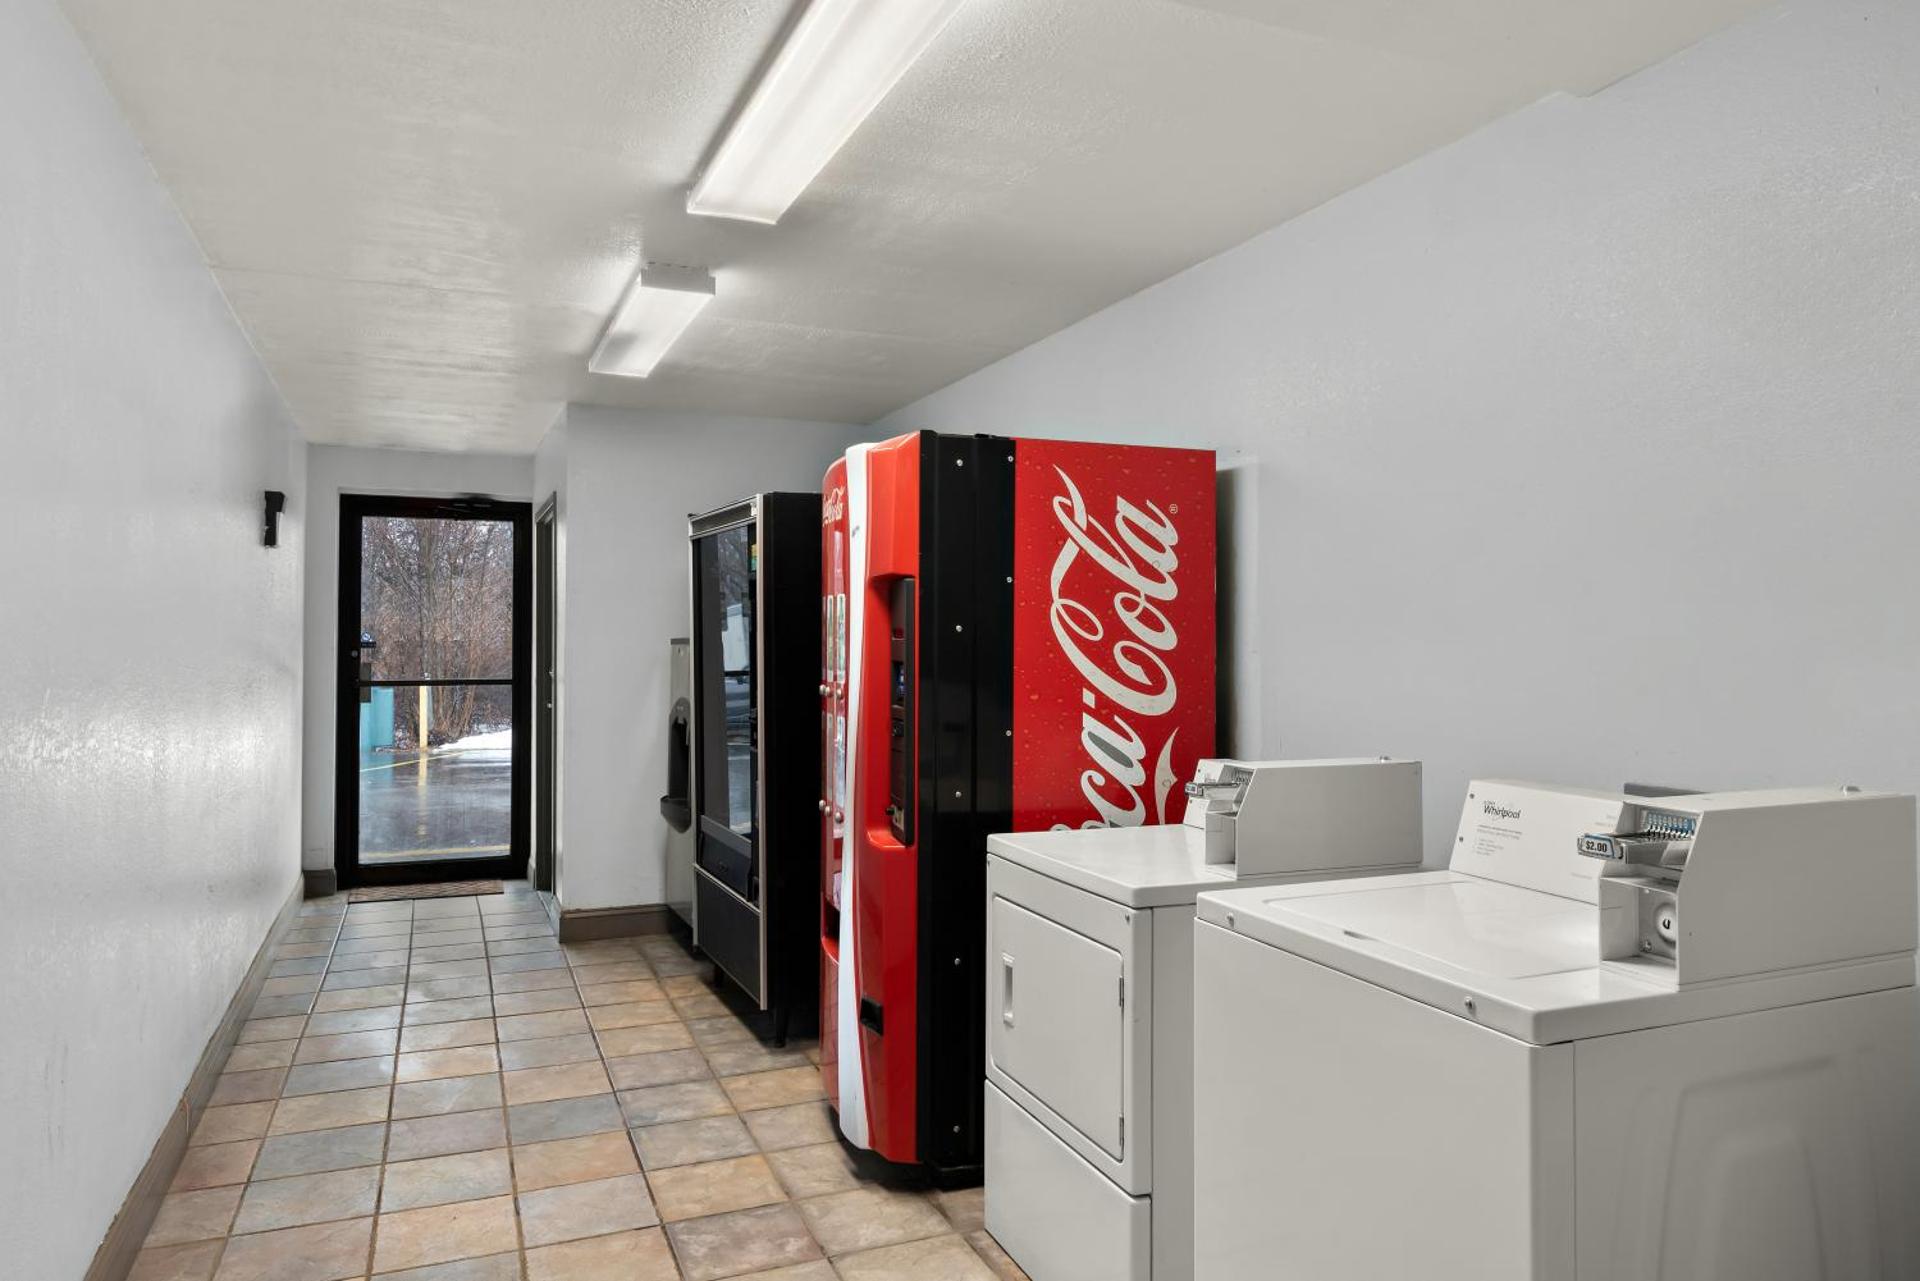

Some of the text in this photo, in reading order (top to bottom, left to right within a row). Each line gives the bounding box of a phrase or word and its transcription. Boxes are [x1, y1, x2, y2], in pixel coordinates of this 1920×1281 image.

[1050, 464, 1179, 831] ca-Cola
[1484, 805, 1521, 819] Whirlpool
[1586, 840, 1607, 852] $2.00
